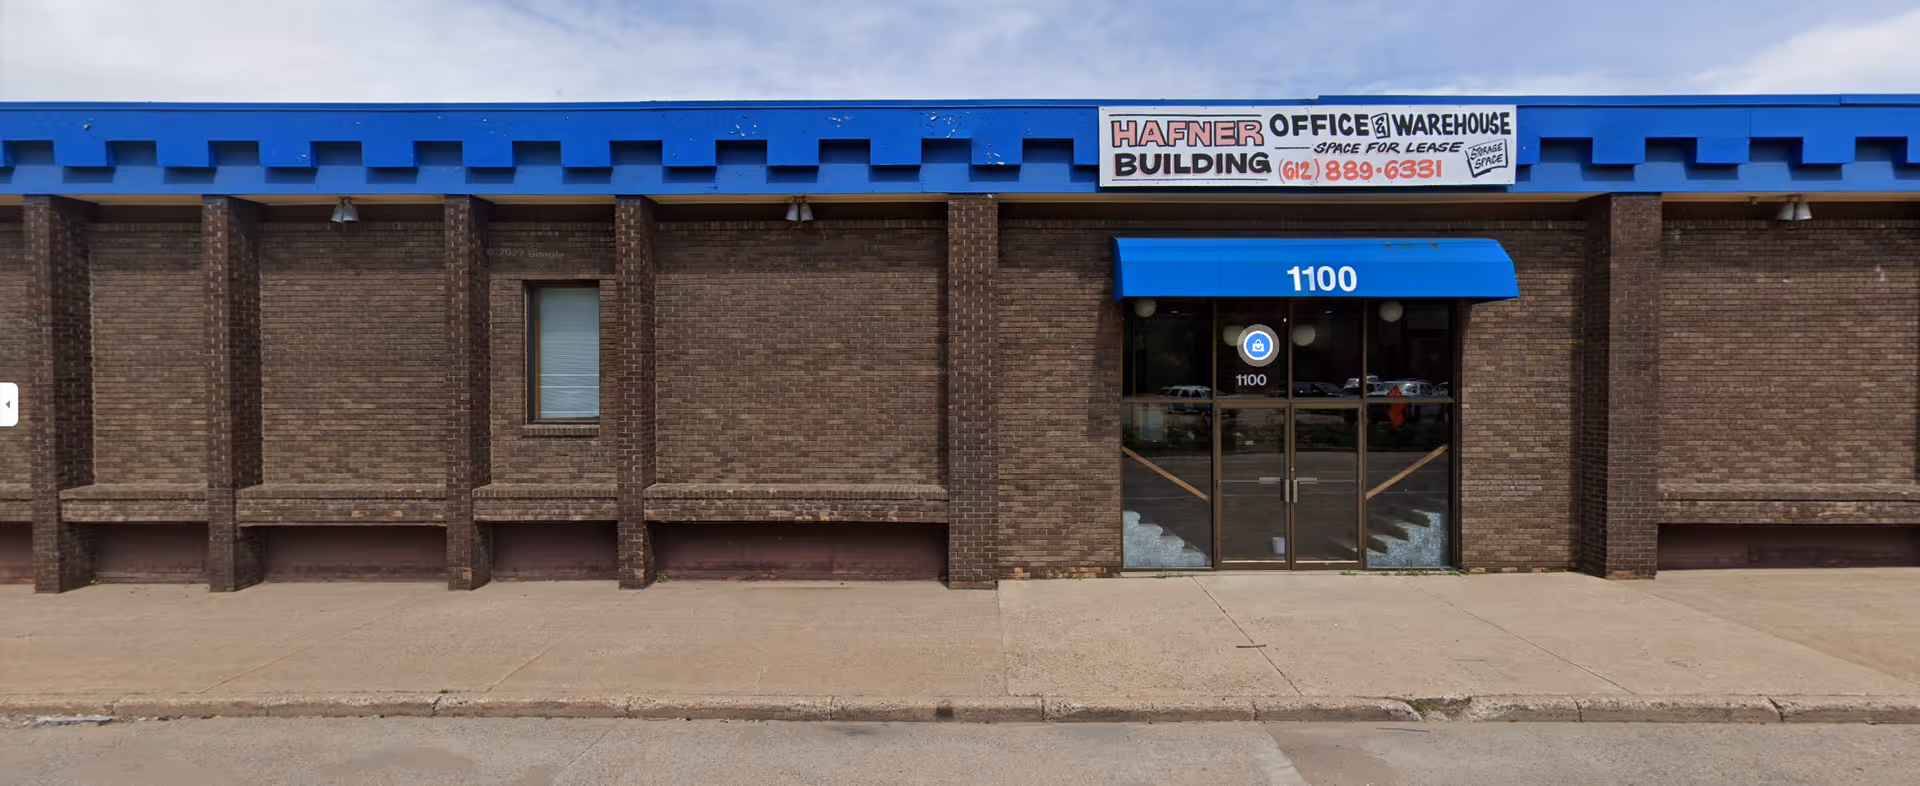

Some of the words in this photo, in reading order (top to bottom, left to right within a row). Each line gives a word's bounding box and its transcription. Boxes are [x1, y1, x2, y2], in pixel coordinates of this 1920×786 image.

[1112, 120, 1265, 147] HAFNER
[1270, 114, 1370, 137] OFFICE
[1392, 112, 1511, 136] WAREHOUSE
[1313, 142, 1361, 154] SPACE
[1366, 142, 1400, 154] FOR
[1407, 142, 1464, 153] LEASE
[1470, 142, 1503, 160] STORAGE
[1113, 152, 1272, 176] BUILDING
[1279, 159, 1320, 184] (612)
[1474, 154, 1503, 169] SPACE
[1286, 265, 1357, 292] 1100
[1235, 374, 1267, 386] 1100
